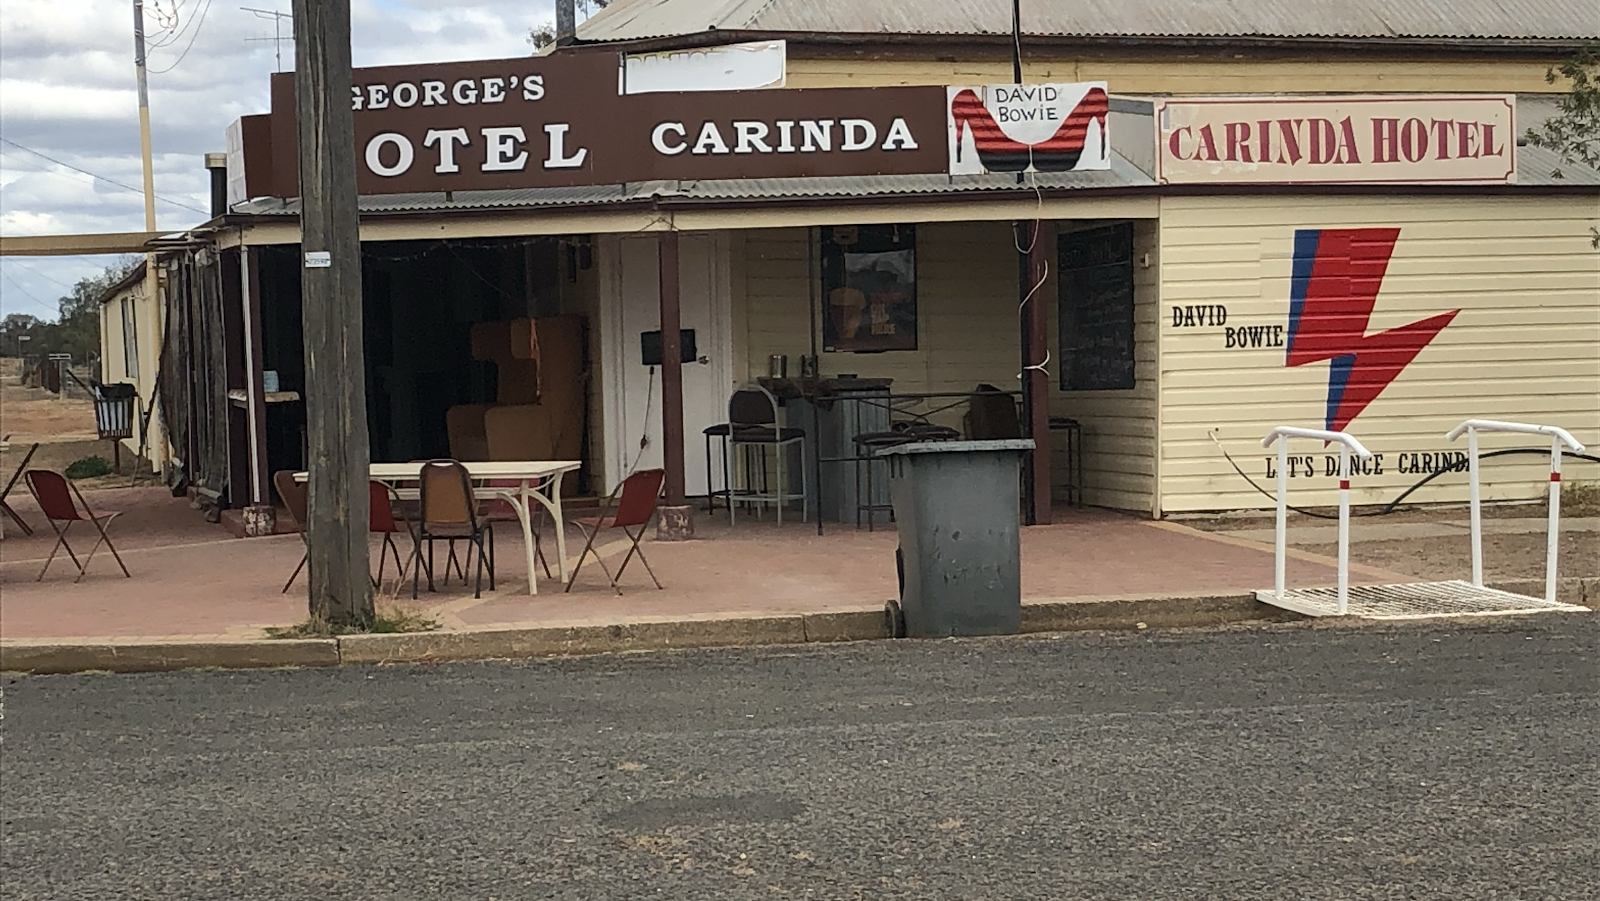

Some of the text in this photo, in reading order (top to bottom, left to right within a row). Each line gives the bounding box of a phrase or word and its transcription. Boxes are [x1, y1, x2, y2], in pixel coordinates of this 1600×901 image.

[995, 87, 1057, 103] DAVID
[998, 105, 1059, 123] BOWIE
[651, 118, 918, 155] CARINDA
[1168, 115, 1504, 166] CARINDA HOTEL
[365, 123, 587, 177] OTEL
[1172, 305, 1227, 327] DAVID
[1225, 325, 1284, 348] BOWIE
[1265, 456, 1314, 479] LT'S
[1398, 451, 1470, 476] CARIND
